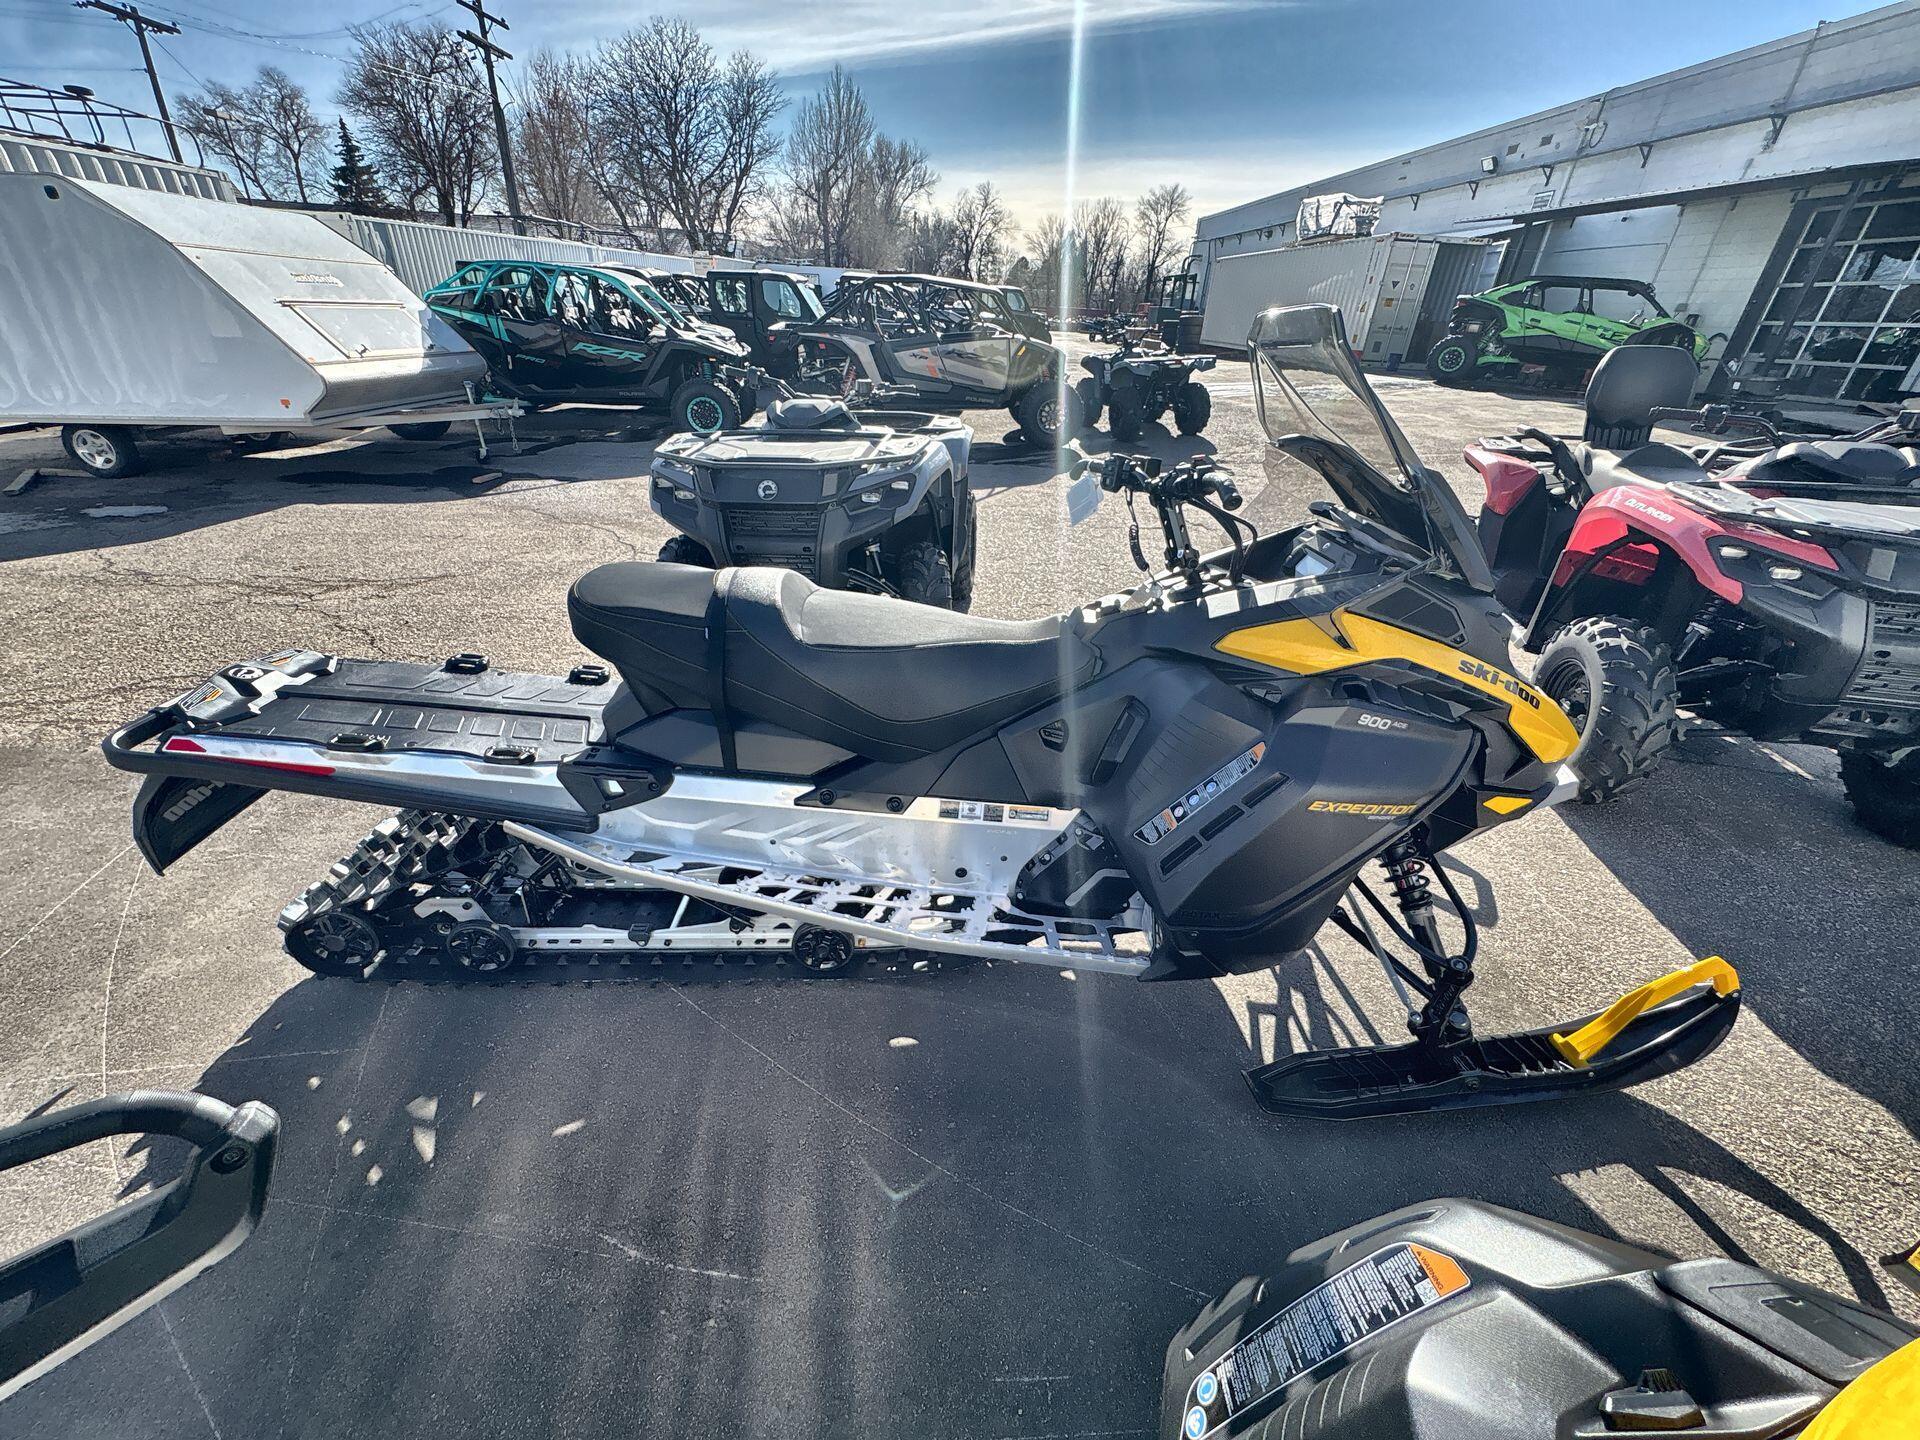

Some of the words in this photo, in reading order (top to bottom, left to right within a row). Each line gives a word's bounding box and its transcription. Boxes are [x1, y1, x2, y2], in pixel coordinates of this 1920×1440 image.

[514, 353, 546, 364] PRO
[571, 342, 647, 363] RZR
[1624, 497, 1676, 524] OUTLANDER
[1457, 659, 1541, 710] ski-doo
[1357, 713, 1392, 730] 900
[1392, 721, 1409, 729] ACE
[1307, 800, 1418, 815] EXPEDITION
[1421, 1256, 1444, 1291] WARNING
